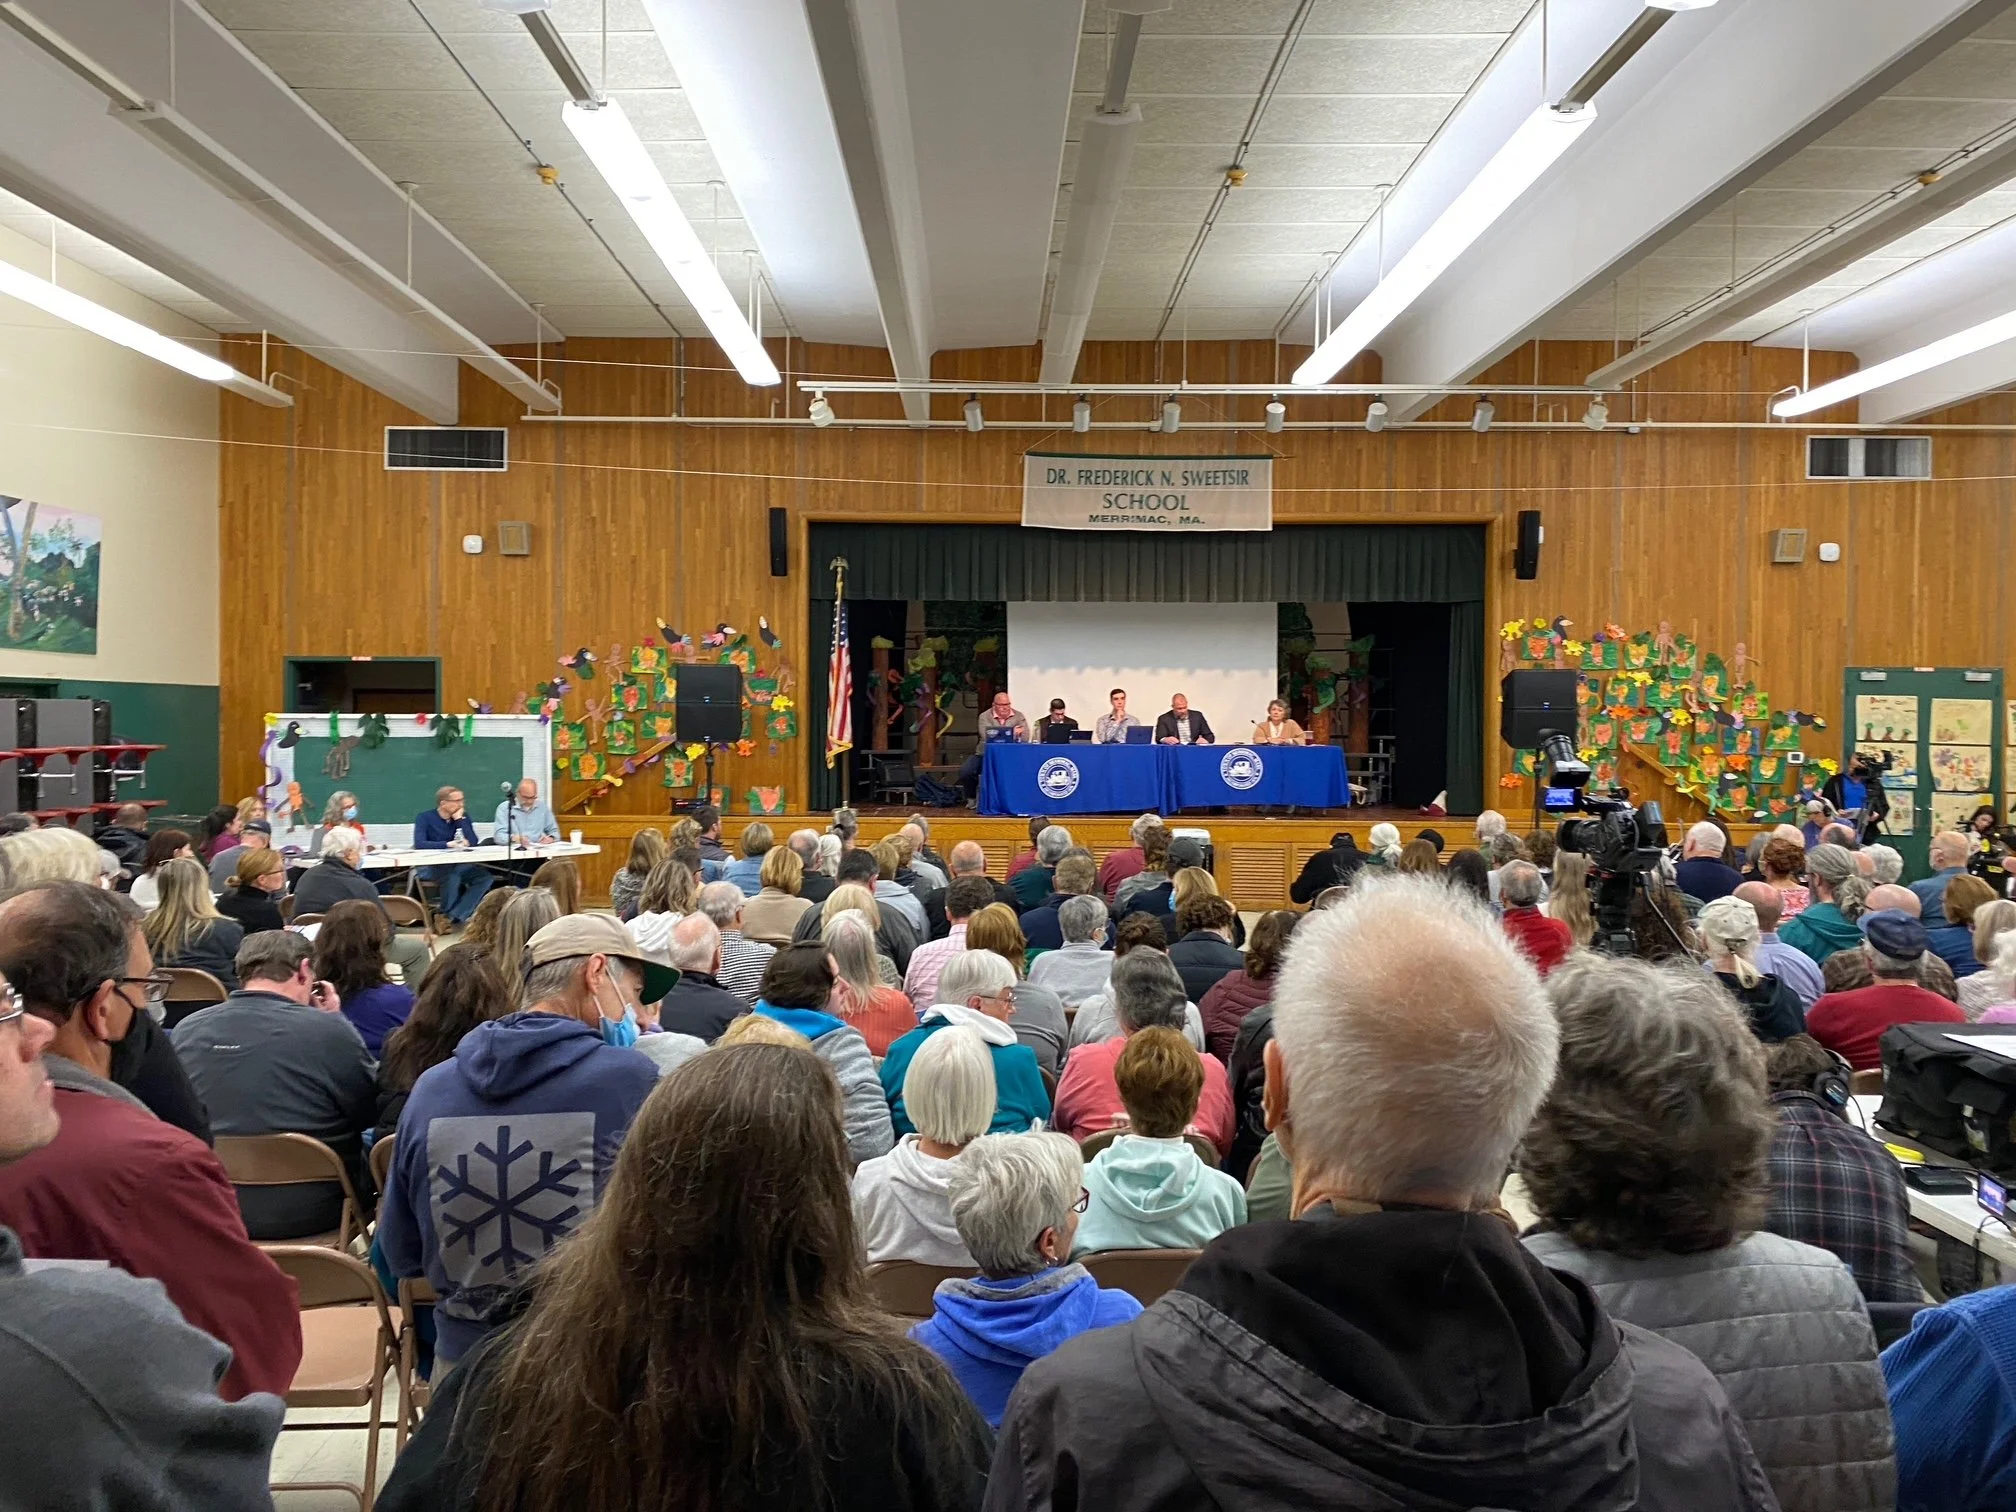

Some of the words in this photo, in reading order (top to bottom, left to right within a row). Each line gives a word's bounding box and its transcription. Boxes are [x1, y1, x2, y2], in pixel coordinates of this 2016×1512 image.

[1046, 468, 1071, 485] DR.
[1077, 469, 1154, 486] FREDERICK
[1160, 470, 1175, 487] N.
[1181, 469, 1249, 486] SWEETSIR
[1103, 493, 1190, 511] SCHOOL
[1088, 514, 1172, 525] MERRIMAC,
[1179, 516, 1206, 525] MA.
